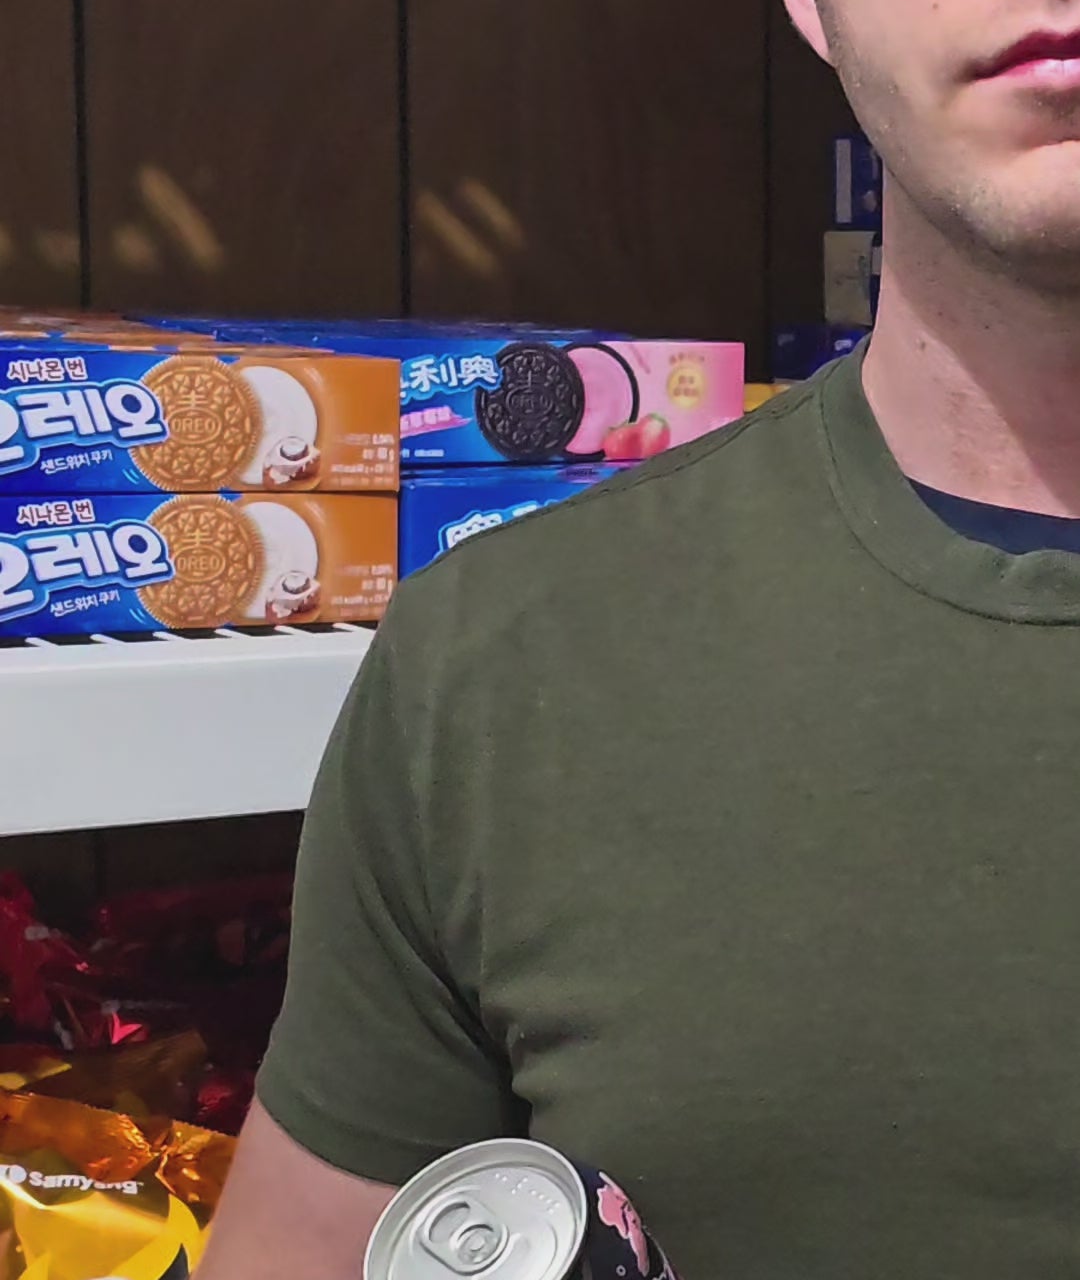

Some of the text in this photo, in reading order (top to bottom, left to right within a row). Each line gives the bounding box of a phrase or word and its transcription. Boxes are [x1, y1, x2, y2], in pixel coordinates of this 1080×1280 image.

[9, 358, 86, 381] 시나몬 번
[171, 417, 217, 433] OREO
[19, 501, 93, 525] 시나몬 번
[177, 556, 220, 571] OREO
[28, 1170, 138, 1195] Samyang
